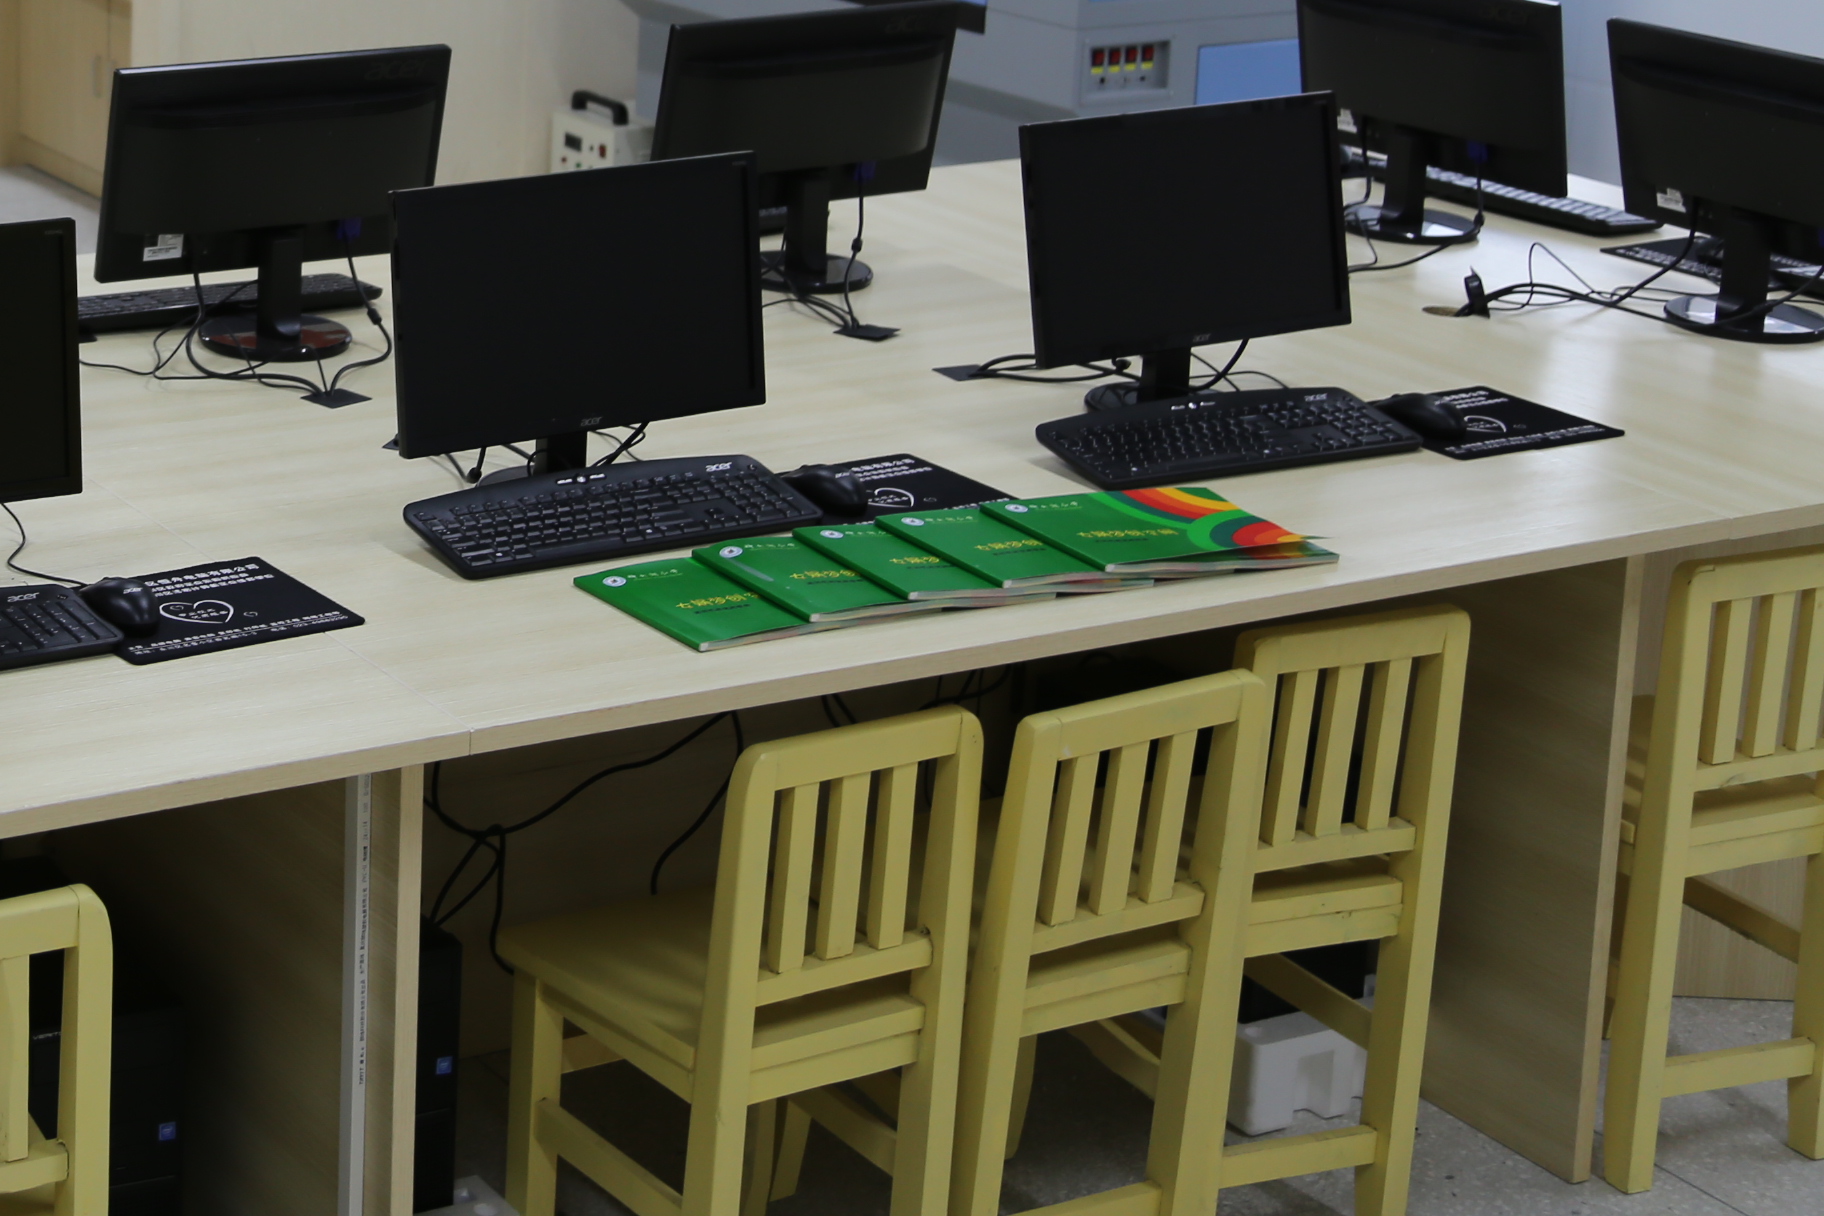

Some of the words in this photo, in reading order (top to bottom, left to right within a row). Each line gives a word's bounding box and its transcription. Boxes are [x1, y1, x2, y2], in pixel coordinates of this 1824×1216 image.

[580, 417, 603, 426] acer
[705, 462, 733, 472] acer
[7, 592, 40, 603] acer
